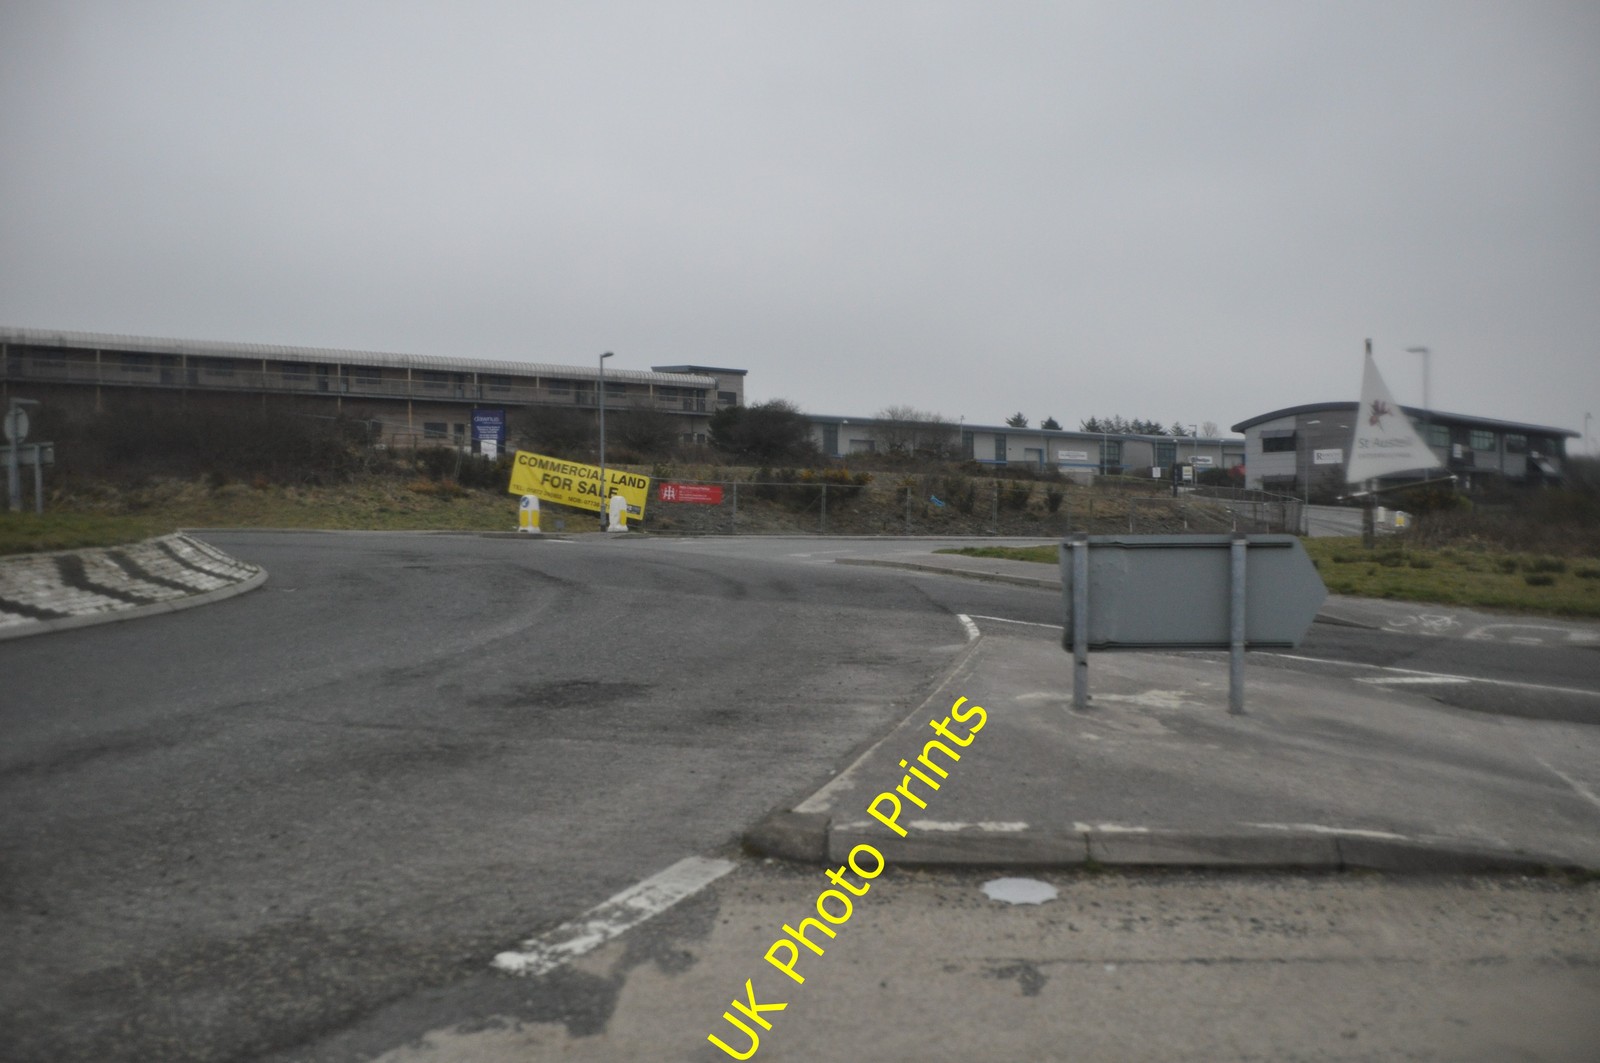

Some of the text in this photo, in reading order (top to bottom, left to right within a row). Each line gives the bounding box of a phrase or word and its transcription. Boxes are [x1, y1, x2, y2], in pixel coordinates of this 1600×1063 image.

[518, 454, 647, 489] COMMERCIAL LAND
[541, 473, 573, 491] FOR
[577, 480, 619, 500] SALE
